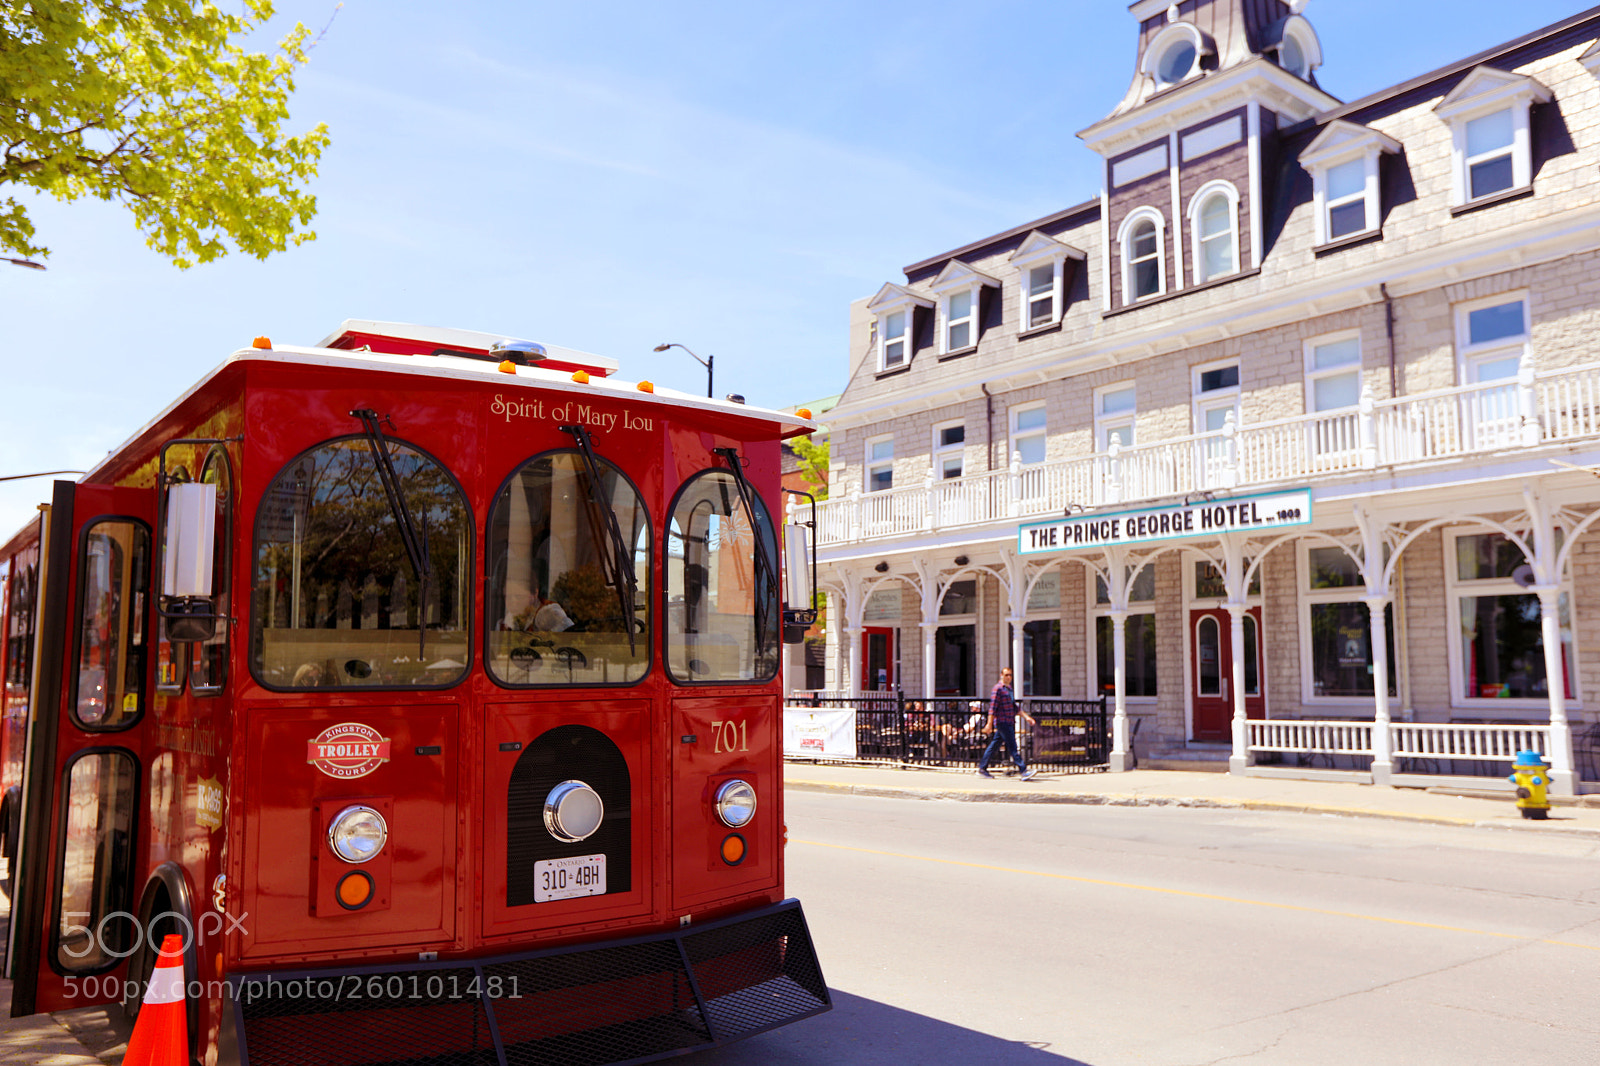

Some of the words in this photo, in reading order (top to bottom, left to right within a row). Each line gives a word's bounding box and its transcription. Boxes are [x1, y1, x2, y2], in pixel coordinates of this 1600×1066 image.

[490, 393, 546, 422] Spirit
[551, 402, 574, 422] of
[576, 404, 618, 434] Mary
[623, 409, 654, 432] Lou
[1030, 527, 1058, 548] THE
[1063, 520, 1121, 545] PRINCE
[1126, 509, 1194, 537] GEORGE
[1201, 502, 1263, 528] HOTEL
[326, 725, 373, 739] KINGSTON
[711, 719, 749, 753] 701
[317, 744, 380, 758] TROLLEY
[331, 766, 366, 776] TOURS
